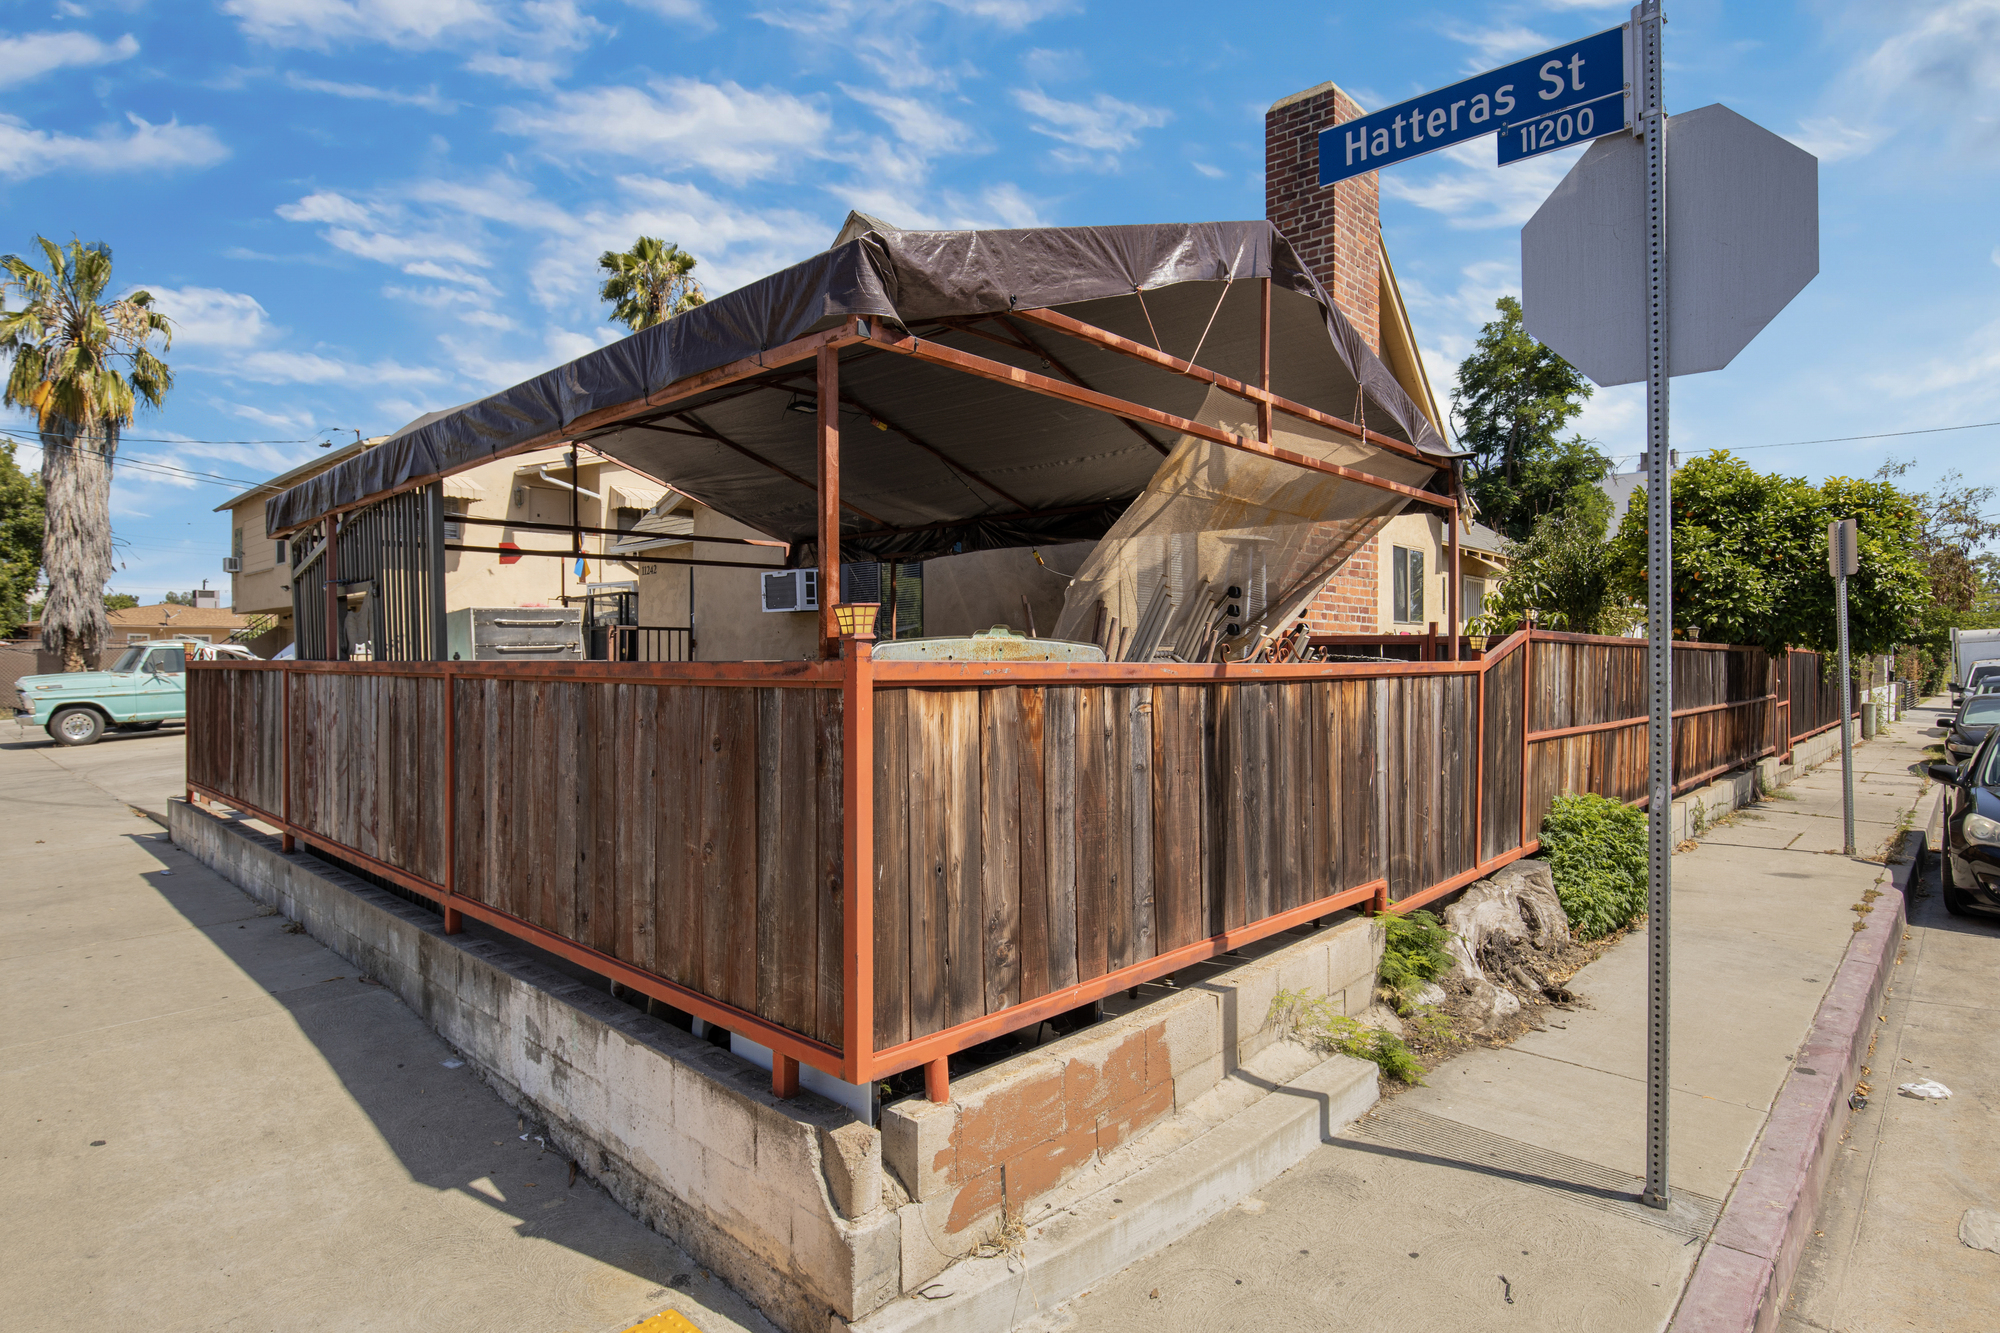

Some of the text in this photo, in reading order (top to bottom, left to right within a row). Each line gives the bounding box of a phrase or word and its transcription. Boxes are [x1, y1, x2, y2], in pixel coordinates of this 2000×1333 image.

[1345, 52, 1585, 166] Hatteras St
[1521, 107, 1594, 153] 11200
[641, 564, 657, 575] 11242
